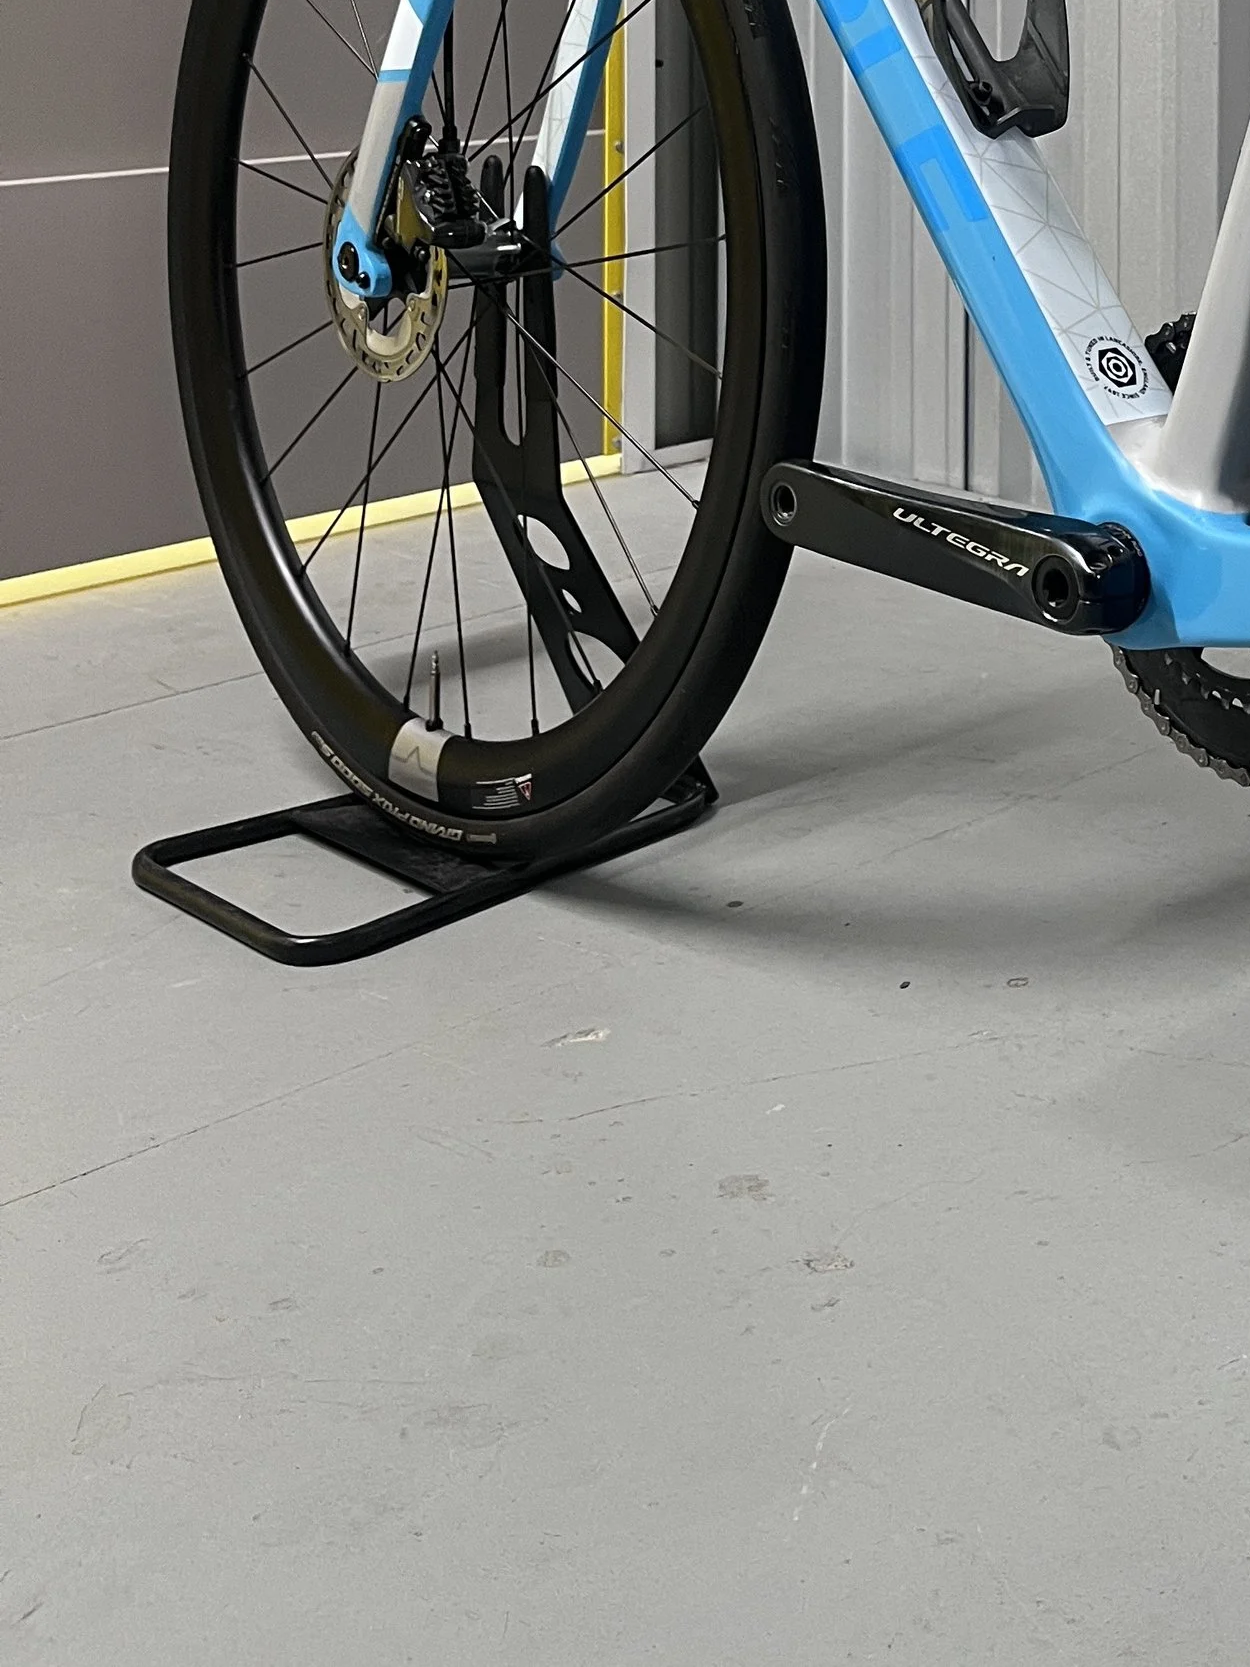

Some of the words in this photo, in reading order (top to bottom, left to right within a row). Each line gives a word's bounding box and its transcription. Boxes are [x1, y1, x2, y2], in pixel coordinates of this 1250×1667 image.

[893, 508, 1029, 576] ULTEGRA
[371, 792, 411, 821] PRIX
[410, 815, 463, 841] GRAND
